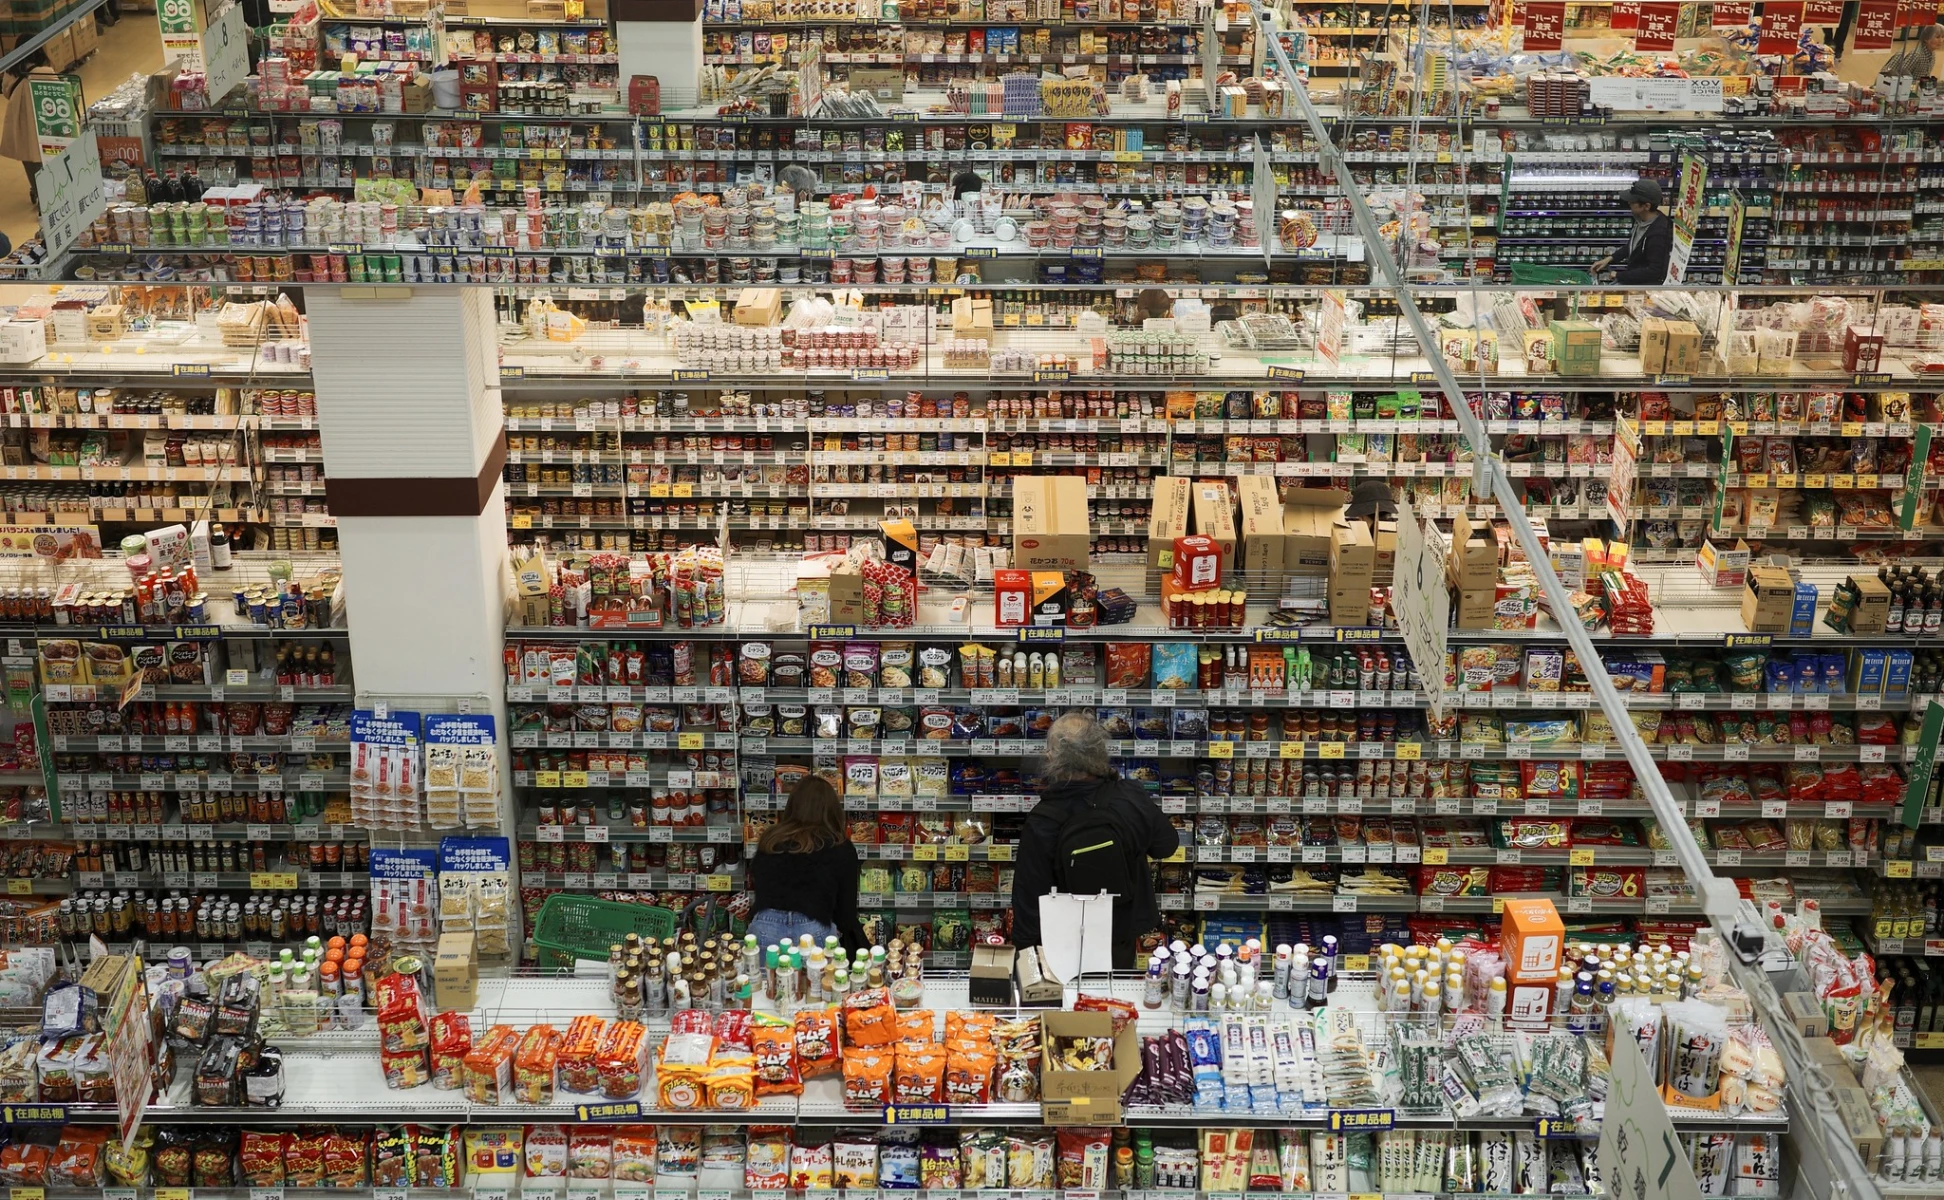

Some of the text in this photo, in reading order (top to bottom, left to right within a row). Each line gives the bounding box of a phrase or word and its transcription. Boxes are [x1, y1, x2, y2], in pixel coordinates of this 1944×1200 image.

[1263, 397, 1273, 416] のり
[159, 549, 174, 557] 麦茶
[1061, 557, 1075, 566] 70g
[1264, 630, 1298, 638] 在庫品棚
[1344, 630, 1379, 638] 在庫品棚
[1736, 636, 1770, 644] 在庫品棚
[1544, 656, 1552, 679] グラタン
[1552, 655, 1561, 678] 北海道
[850, 768, 873, 778] ツナマヨ
[1559, 769, 1570, 789] 3
[1507, 787, 1518, 799] 3
[1548, 823, 1561, 846] 3
[1461, 874, 1473, 895] 2
[1622, 873, 1637, 894] 6
[973, 996, 1003, 1004] MAILLE
[795, 1029, 831, 1042] キムチ
[757, 1052, 791, 1066] キムチ
[1678, 1038, 1696, 1092] 十割そば
[845, 1086, 882, 1098] キムチ
[896, 1084, 931, 1097] キムチ
[946, 1081, 983, 1094] キムチ
[16, 1108, 64, 1118] 在庫品棚
[590, 1104, 638, 1116] 在庫品棚
[898, 1108, 946, 1119] 在庫品棚
[1344, 1114, 1391, 1124] 在庫品棚
[482, 1133, 506, 1141] MUG
[530, 1137, 566, 1145] やきそば
[658, 1140, 700, 1153] 塩ラーメン
[835, 1156, 874, 1168] 札幌みそ
[1211, 1154, 1221, 1180] 中華麺
[1486, 1140, 1498, 1191] そうめん
[1521, 1145, 1532, 1187] うどん
[1700, 1135, 1715, 1193] 十割そば
[1752, 1153, 1765, 1176] そば
[1093, 1156, 1101, 1187] 焼うどん
[746, 1174, 787, 1188] みそラーメン
